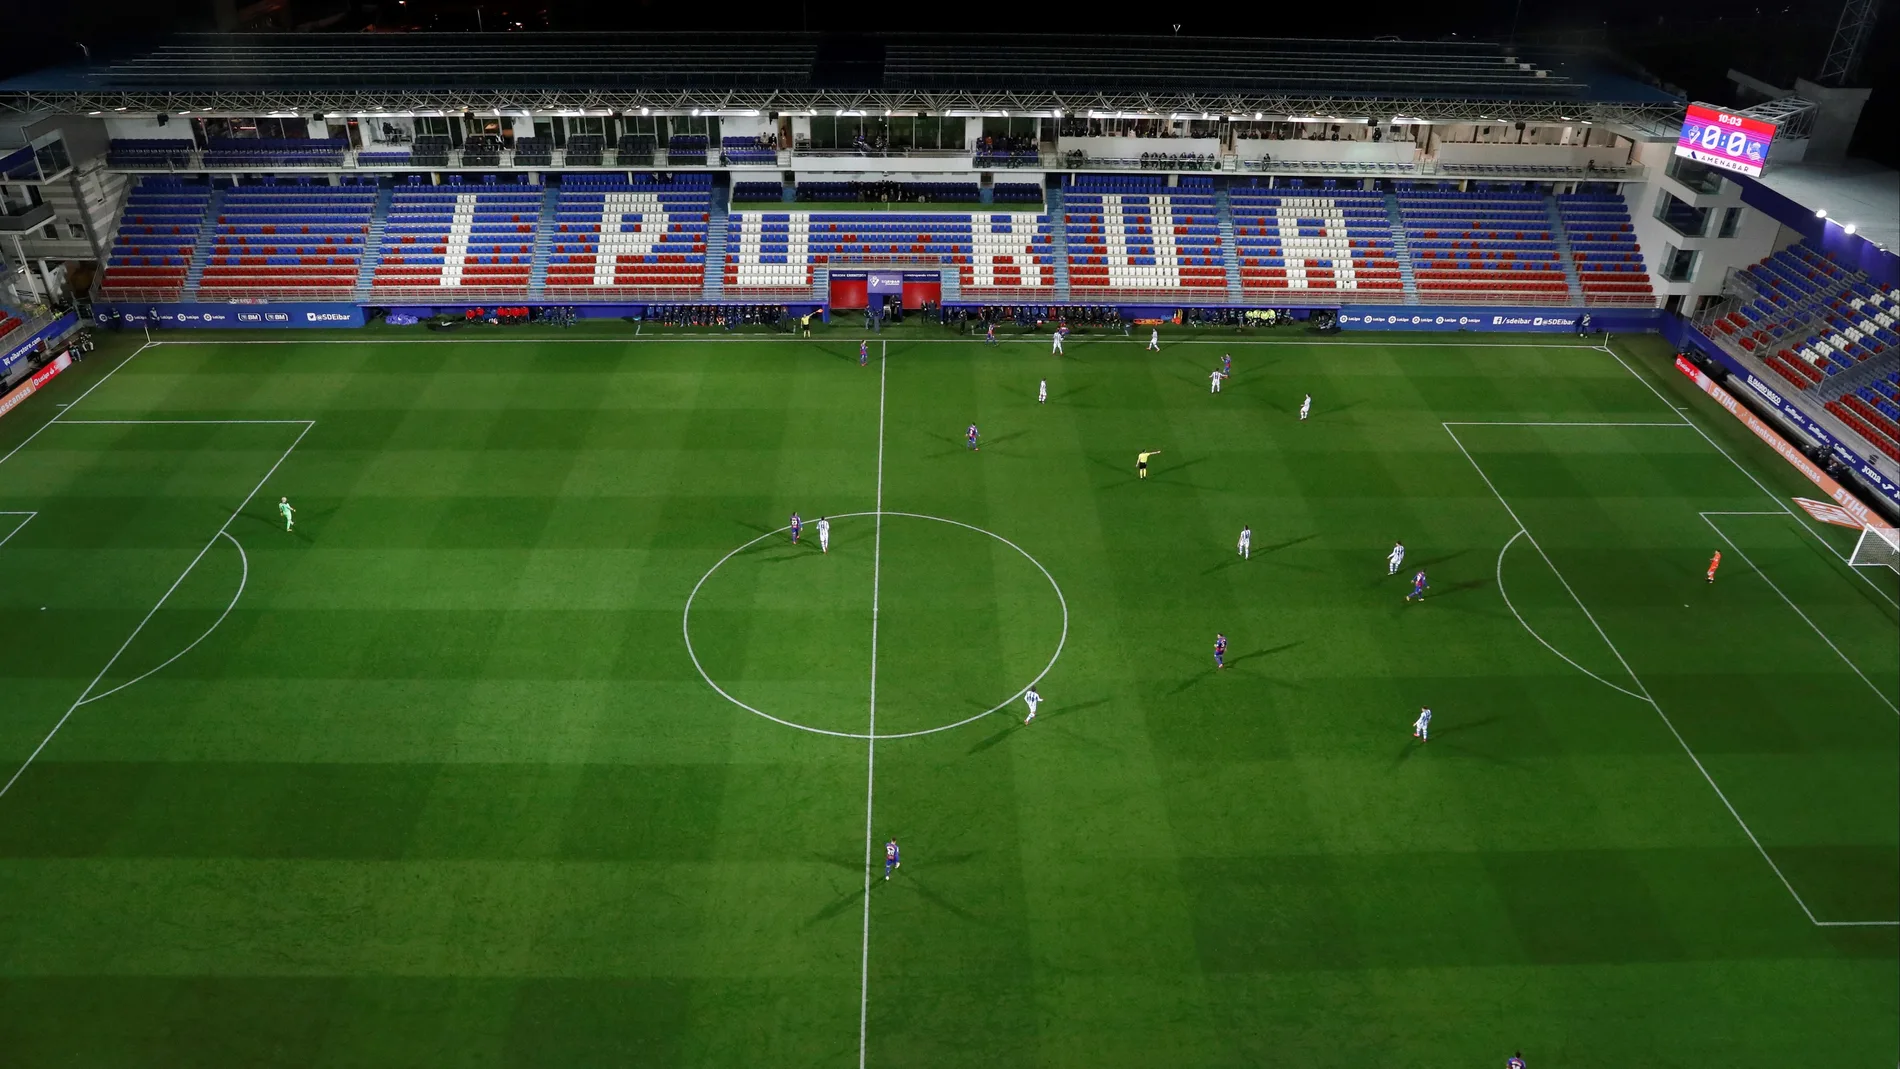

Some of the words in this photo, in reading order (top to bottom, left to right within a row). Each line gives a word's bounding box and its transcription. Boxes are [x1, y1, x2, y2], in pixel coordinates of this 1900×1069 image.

[1719, 114, 1742, 126] 10:03
[1701, 156, 1749, 172] AMENABAR
[10, 337, 41, 361] eibarstore.com
[0, 387, 31, 414] escansas
[1712, 387, 1738, 413] STIHL
[1766, 390, 1782, 404] VASCO
[1747, 417, 1777, 445] Mientras
[1777, 440, 1788, 452] tú
[1785, 449, 1821, 482] descansas
[1833, 488, 1868, 522] STIHL
